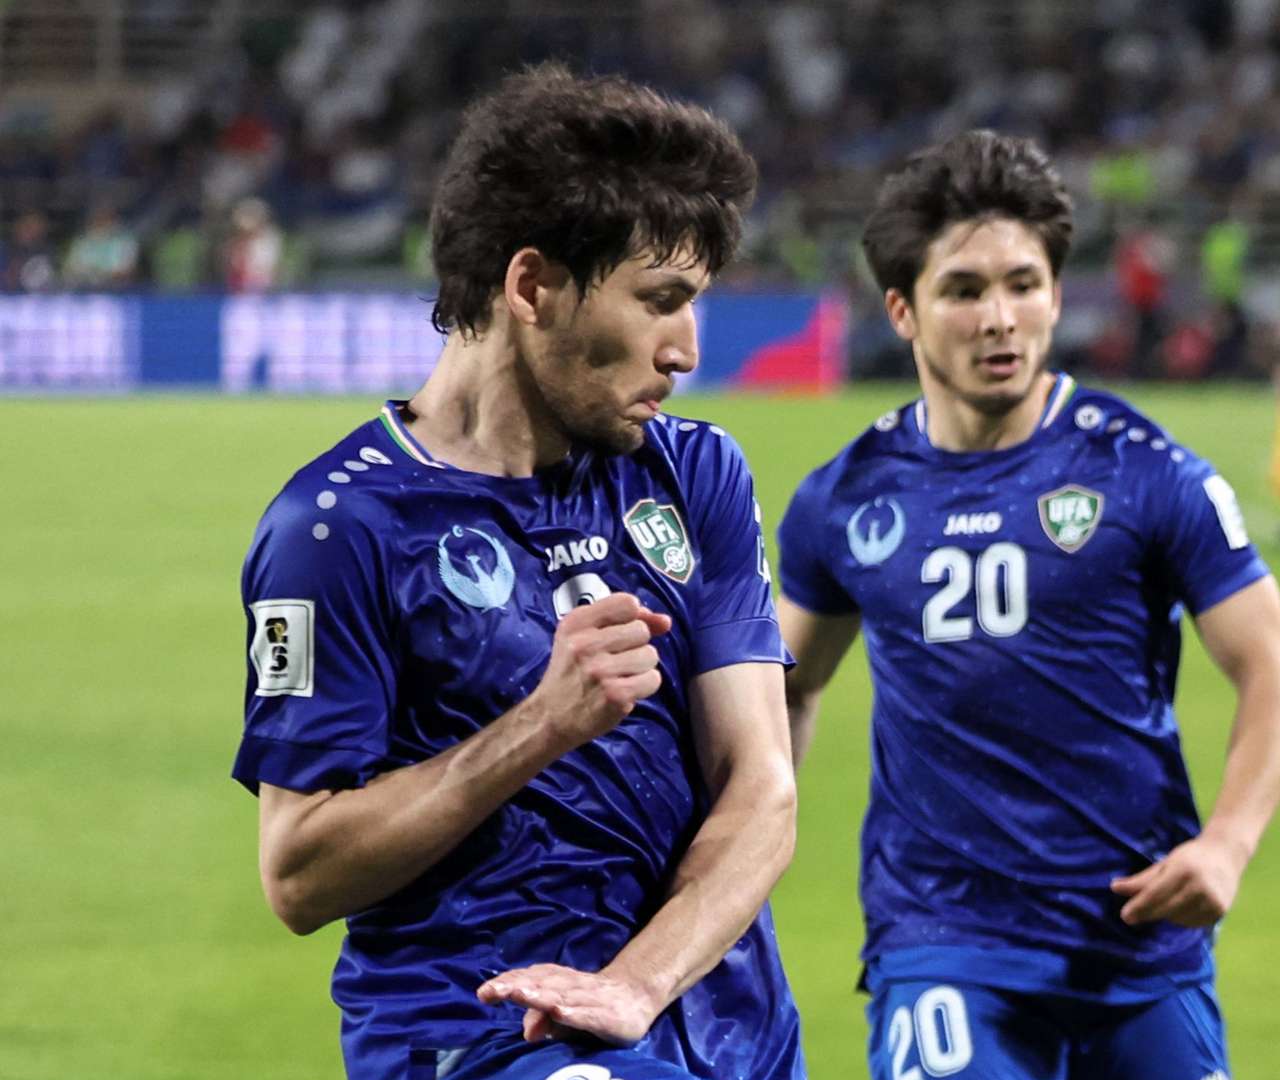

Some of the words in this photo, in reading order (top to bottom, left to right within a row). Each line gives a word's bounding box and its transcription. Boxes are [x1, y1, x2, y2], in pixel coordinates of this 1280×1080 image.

[1049, 497, 1093, 522] UFA
[943, 511, 1003, 536] JAKO
[921, 542, 1028, 644] 20
